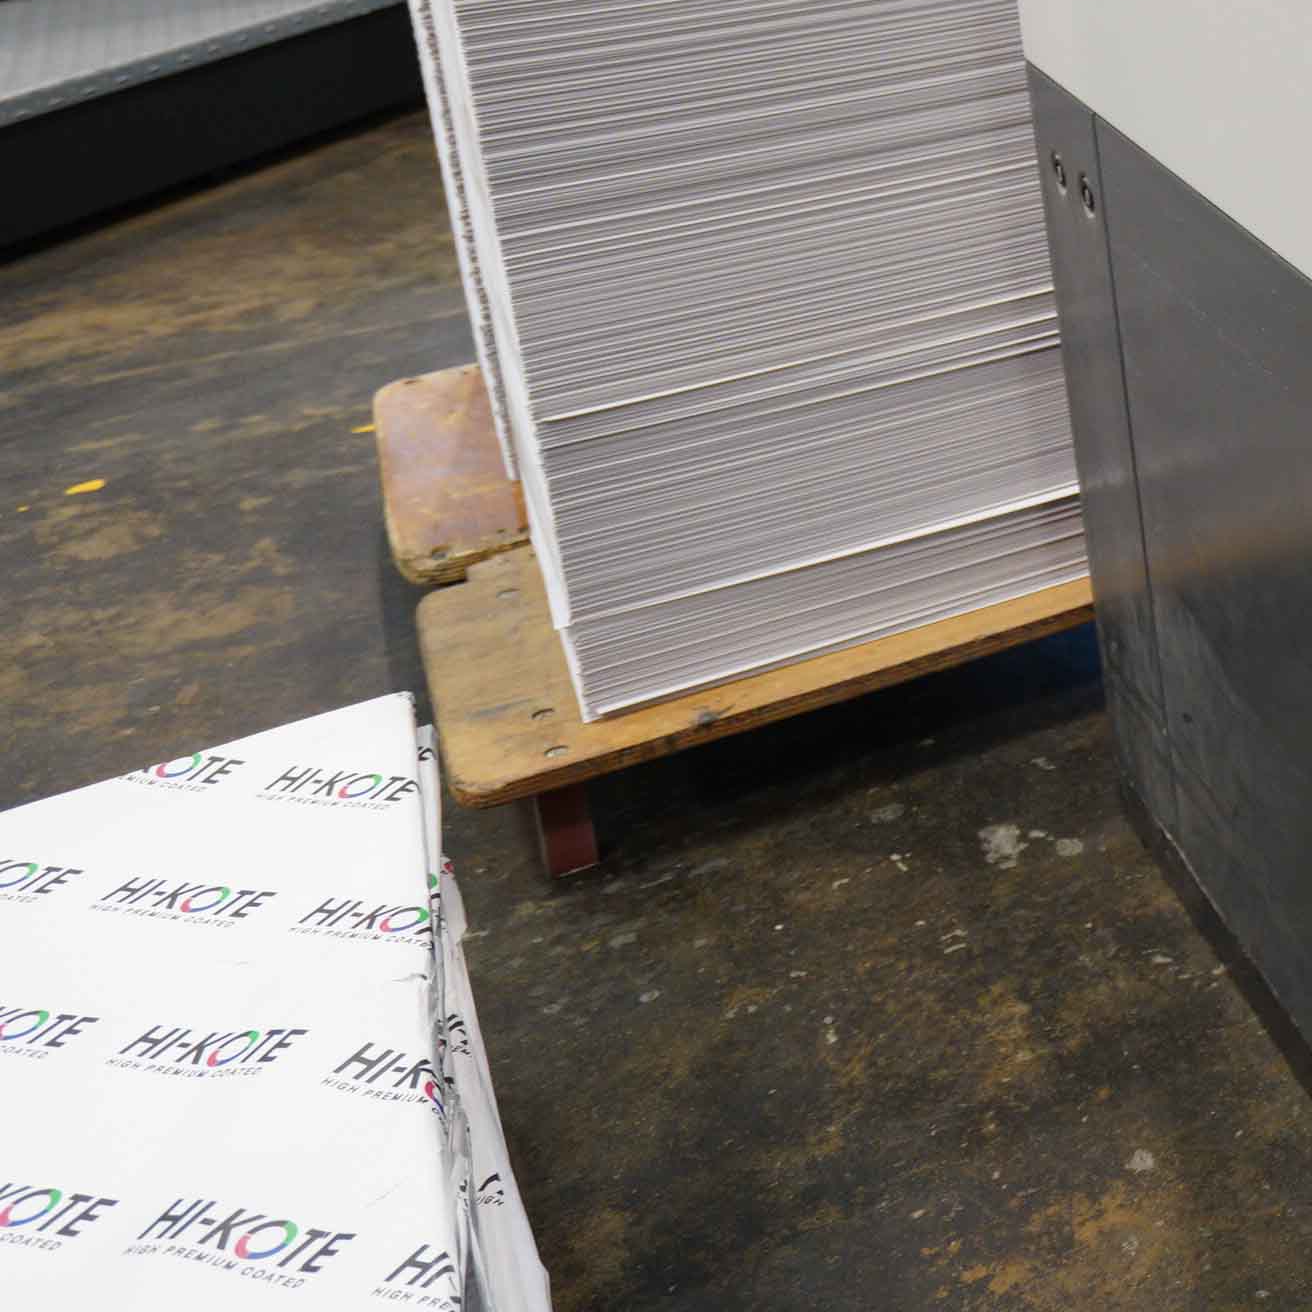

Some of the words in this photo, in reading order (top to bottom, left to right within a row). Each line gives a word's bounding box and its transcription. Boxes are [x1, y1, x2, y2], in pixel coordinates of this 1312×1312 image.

[143, 752, 245, 784] OTE
[265, 766, 421, 801] HI-KOTE
[0, 859, 84, 894] OTE
[100, 876, 278, 919] HI-KOTE
[118, 1024, 309, 1068] HI-KOTE
[321, 1077, 360, 1094] HIGH
[363, 1089, 429, 1104] PREMIUM
[136, 1198, 357, 1274] HI-KOTE
[122, 1242, 160, 1257] HIGH
[161, 1245, 238, 1270] PREMIUM
[240, 1265, 306, 1289] COATED
[369, 1287, 415, 1302] HIGH
